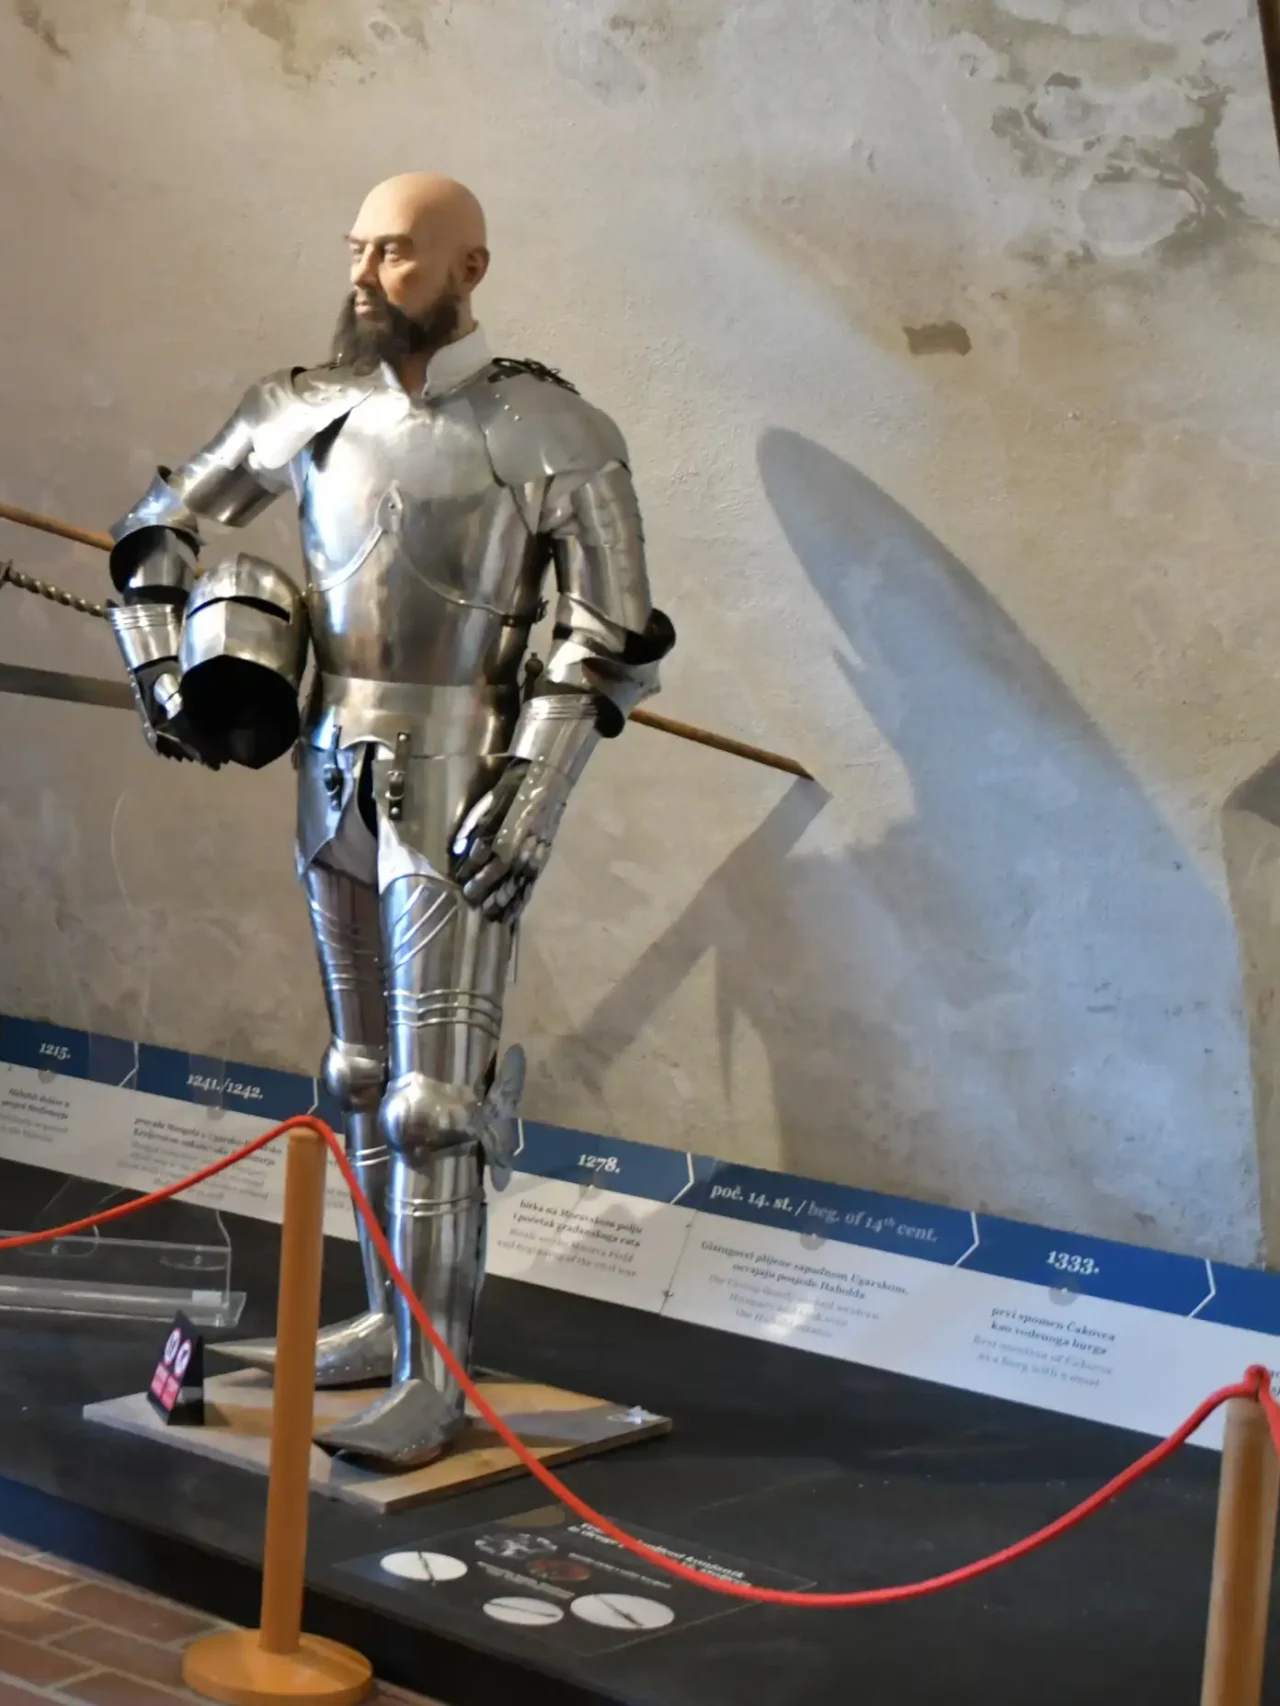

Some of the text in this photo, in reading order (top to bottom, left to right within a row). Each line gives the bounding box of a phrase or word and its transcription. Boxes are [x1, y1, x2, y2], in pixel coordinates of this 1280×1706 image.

[39, 1042, 71, 1060] 1215.
[576, 1152, 621, 1174] 1278.
[709, 1184, 744, 1202] poč.
[747, 1191, 770, 1209] 14.
[772, 1197, 793, 1212] st.
[807, 1200, 841, 1225] beg.
[845, 1209, 867, 1226] of
[896, 1223, 939, 1243] cent.
[1045, 1248, 1101, 1277] 1333.
